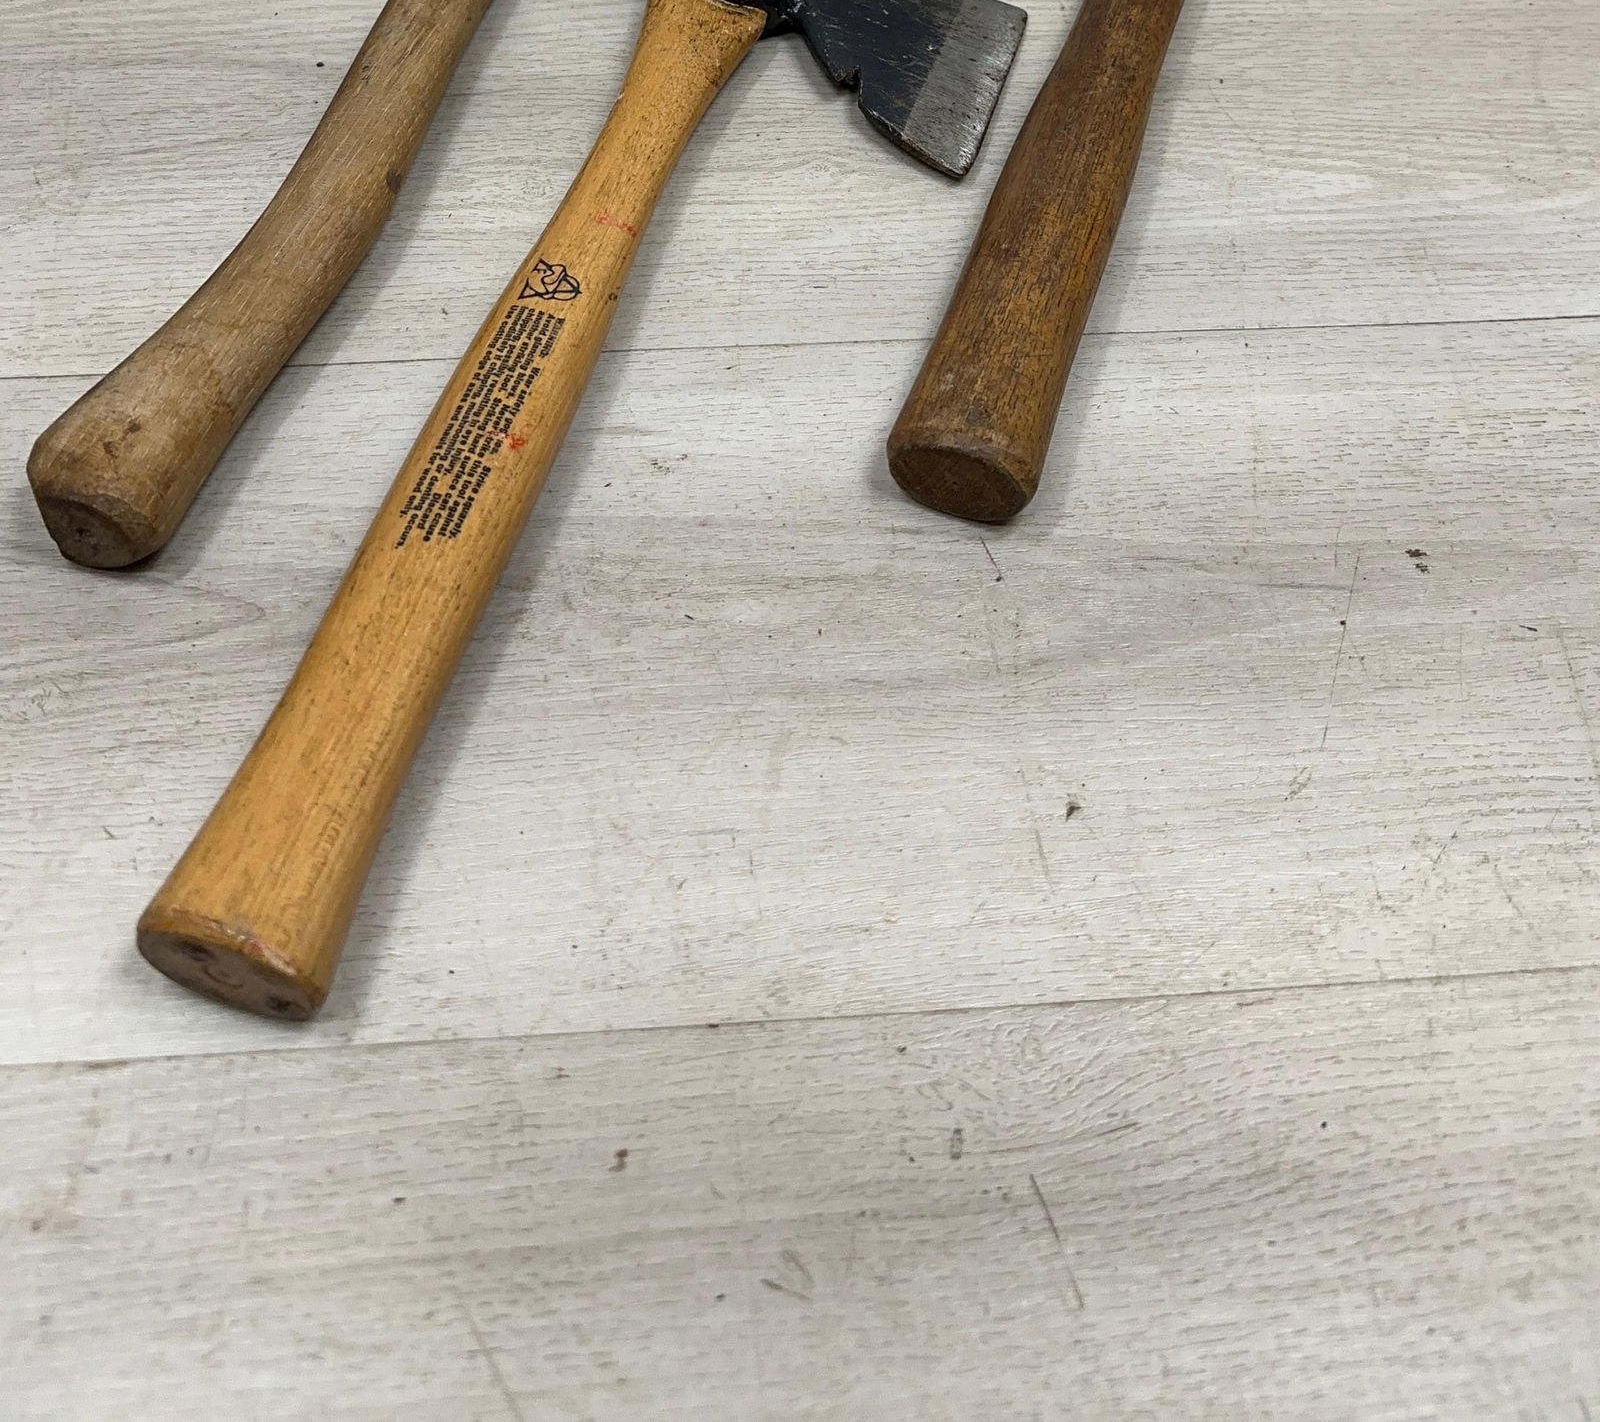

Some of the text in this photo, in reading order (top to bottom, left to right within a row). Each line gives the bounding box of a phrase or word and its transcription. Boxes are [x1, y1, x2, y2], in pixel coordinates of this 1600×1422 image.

[504, 301, 519, 321] Use
[524, 309, 546, 341] another
[475, 347, 494, 372] edge
[506, 339, 530, 375] striking
[471, 370, 482, 381] of
[496, 371, 514, 395] tool.
[522, 364, 541, 390] Wear
[459, 380, 476, 404] axes
[471, 377, 500, 419] resulting
[507, 387, 530, 418] safety
[434, 312, 556, 538] Avoid glancing blows. Never trike this tool against
[449, 403, 465, 423] and
[468, 416, 480, 429] in
[476, 395, 503, 433] Striking
[434, 420, 456, 452] mauls
[438, 399, 478, 463] mushrooming
[457, 427, 473, 447] eye
[466, 431, 484, 455] hard
[487, 416, 515, 457] gogles.
[426, 449, 441, 467] for
[433, 461, 445, 474] or
[441, 445, 465, 478] injury.
[446, 453, 473, 492] surface
[411, 465, 433, 495] wood
[412, 473, 440, 513] denting
[469, 464, 492, 495] Strike
[396, 492, 418, 521] only.
[415, 490, 442, 531] Discard
[437, 491, 453, 512] can
[393, 511, 419, 551] occurs.
[445, 493, 478, 542] squarely.
